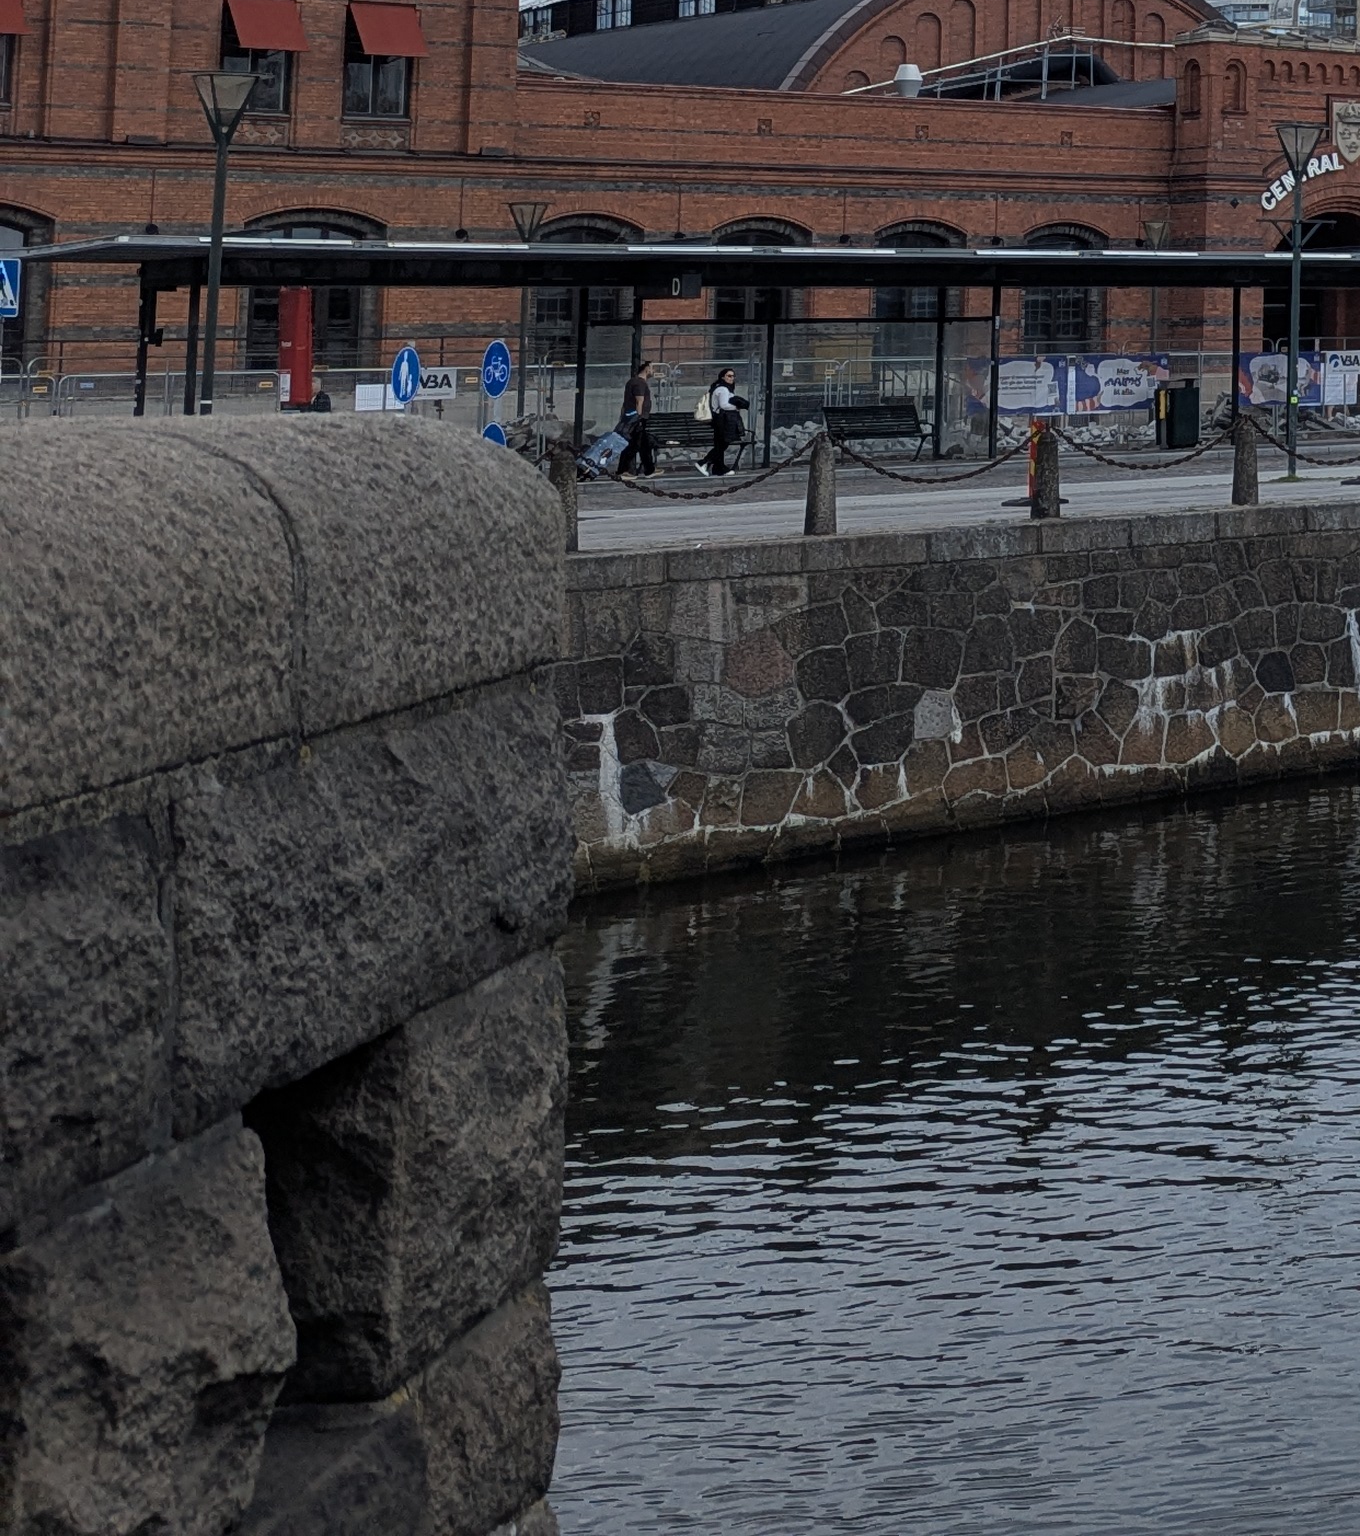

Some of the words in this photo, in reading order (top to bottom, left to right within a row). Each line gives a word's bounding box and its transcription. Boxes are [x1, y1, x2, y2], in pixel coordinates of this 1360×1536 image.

[1261, 153, 1344, 211] CENRAL
[672, 278, 680, 295] D
[1340, 354, 1360, 366] VBA
